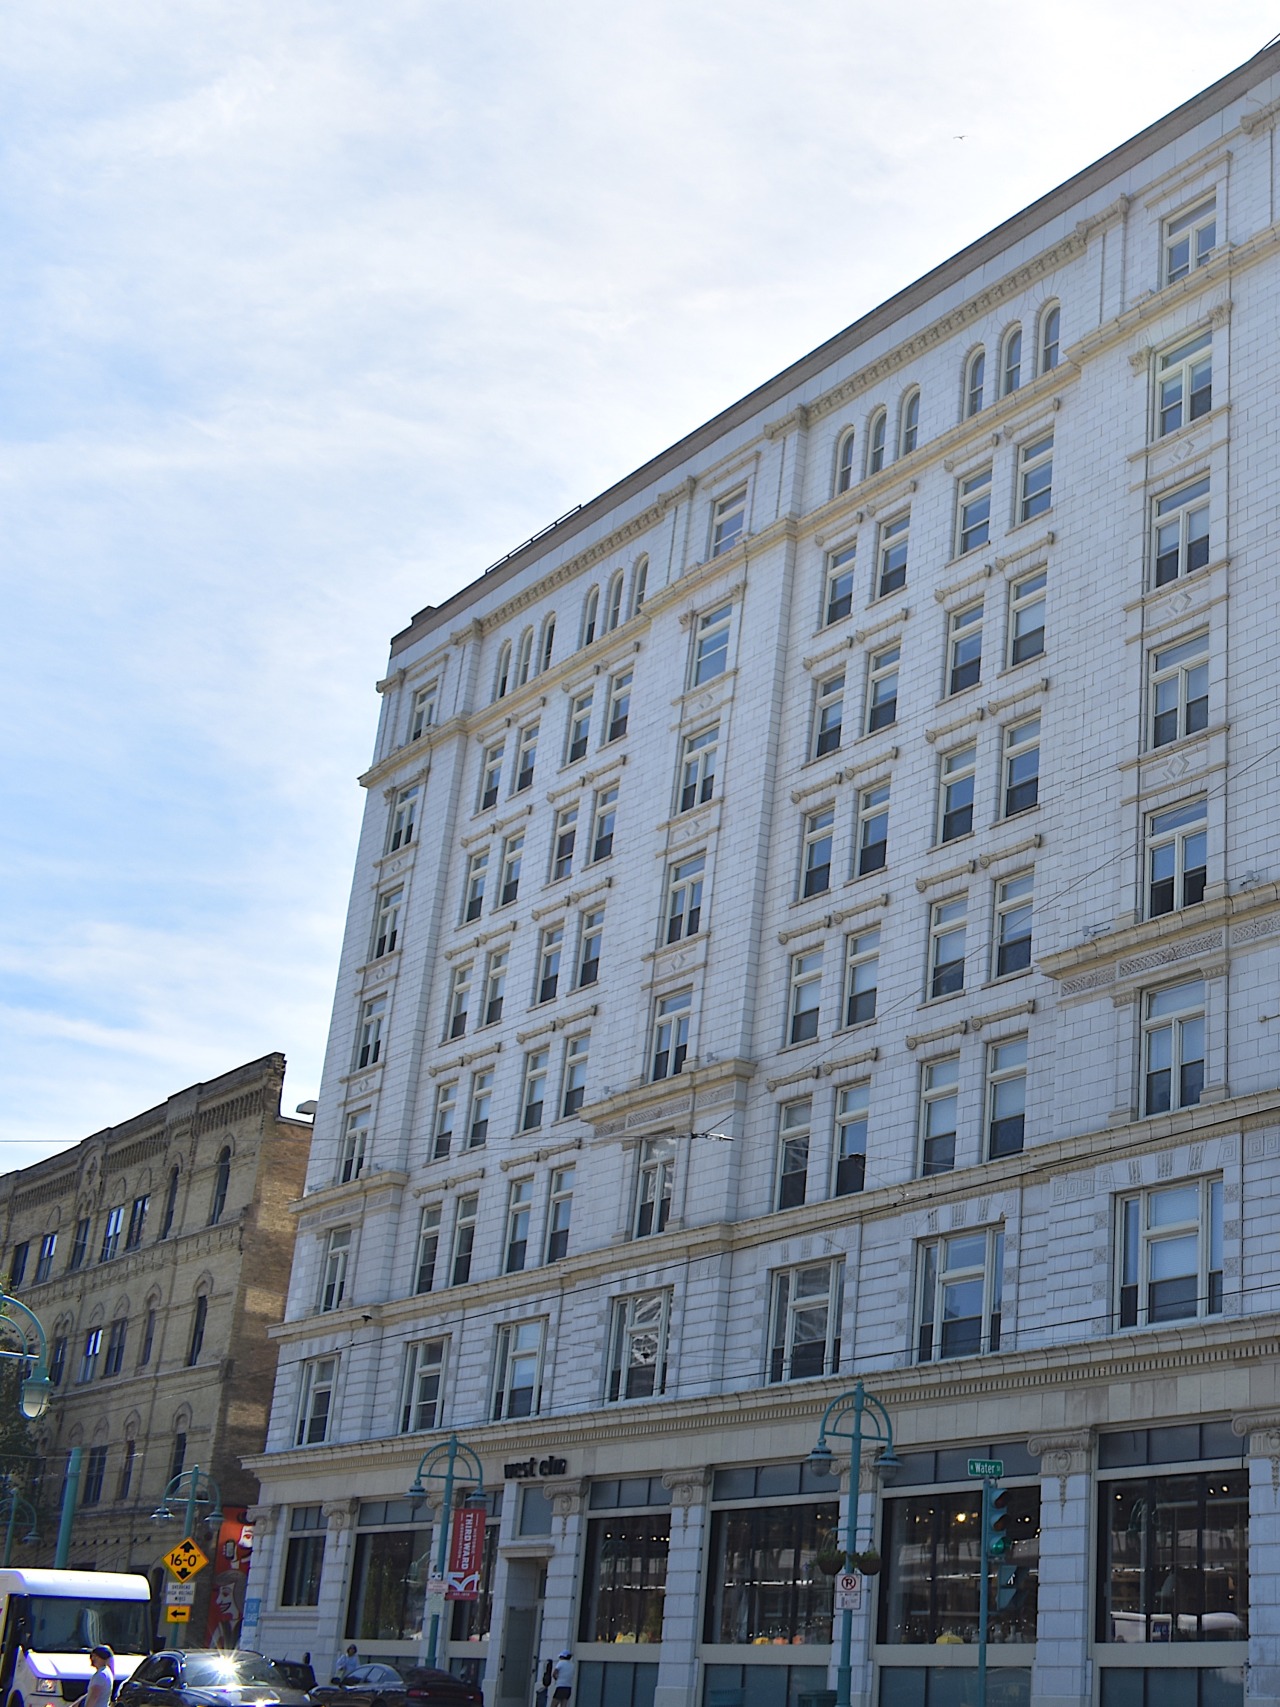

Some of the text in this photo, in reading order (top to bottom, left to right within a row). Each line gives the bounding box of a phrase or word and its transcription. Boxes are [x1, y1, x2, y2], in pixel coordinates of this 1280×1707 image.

[504, 1457, 537, 1479] west
[974, 1462, 995, 1474] Water
[461, 1513, 474, 1570] THIRD WARD
